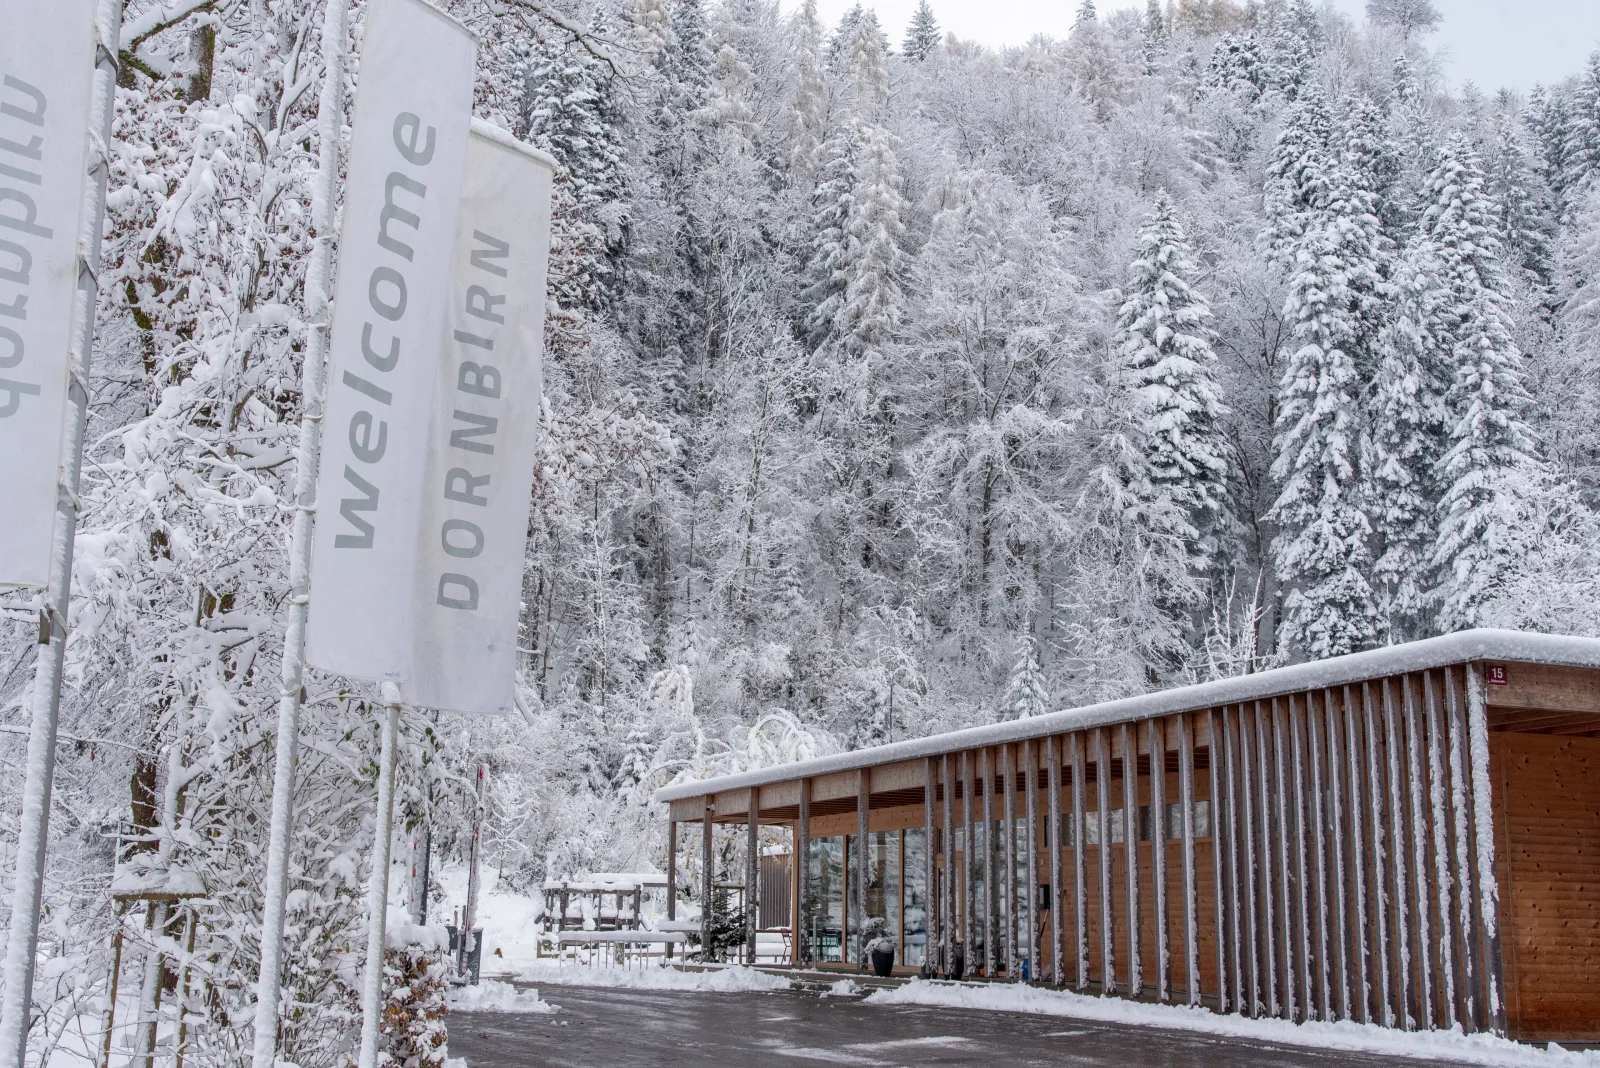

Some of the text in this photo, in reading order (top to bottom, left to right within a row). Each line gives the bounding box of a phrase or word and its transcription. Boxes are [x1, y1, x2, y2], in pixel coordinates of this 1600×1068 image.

[334, 112, 436, 549] welcome
[437, 229, 510, 611] DORNBIRN
[1491, 667, 1504, 679] 15
